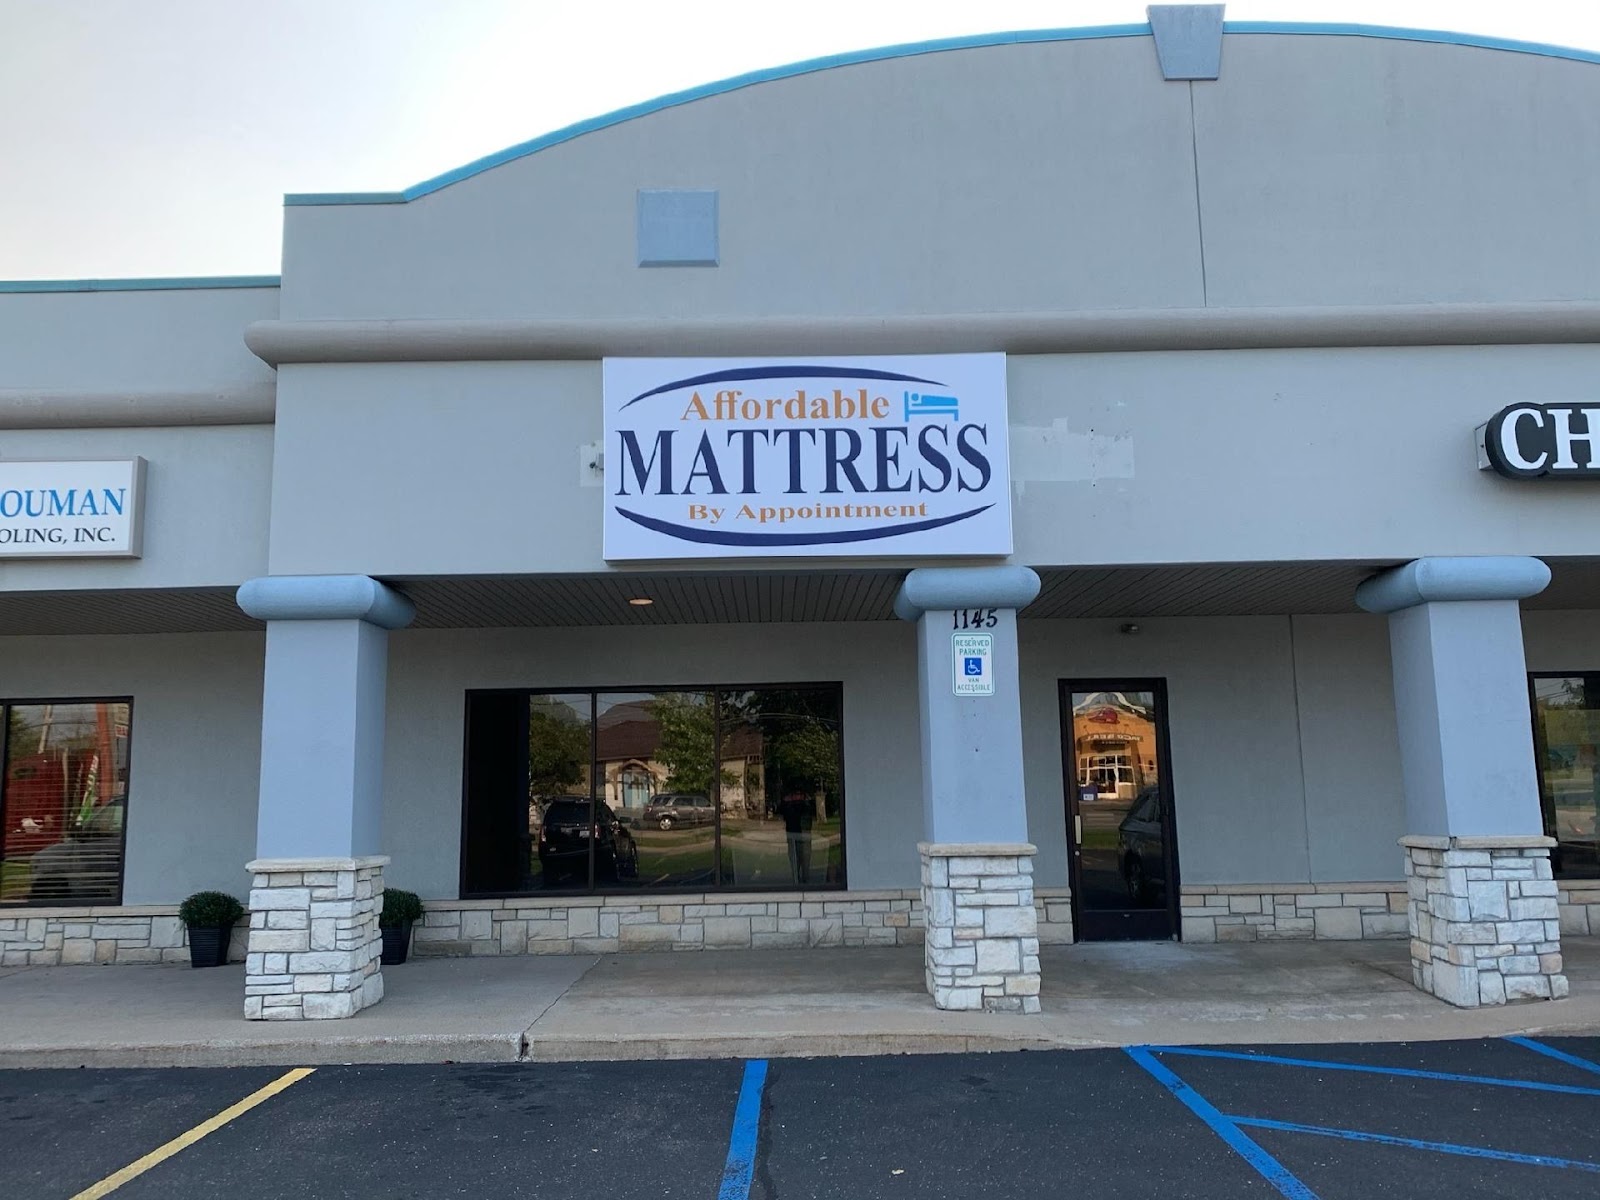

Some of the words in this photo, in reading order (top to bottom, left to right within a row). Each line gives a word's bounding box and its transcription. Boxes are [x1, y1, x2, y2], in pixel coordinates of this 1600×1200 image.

[680, 389, 890, 421] Affordable
[1501, 408, 1600, 469] CH
[614, 423, 992, 496] MATTRESS
[0, 488, 126, 517] OUMAN
[688, 504, 725, 524] By
[735, 502, 929, 523] Appointment
[0, 528, 68, 544] OLING,
[74, 527, 115, 542] INC.
[953, 608, 998, 630] 1145
[959, 648, 987, 656] PARKING
